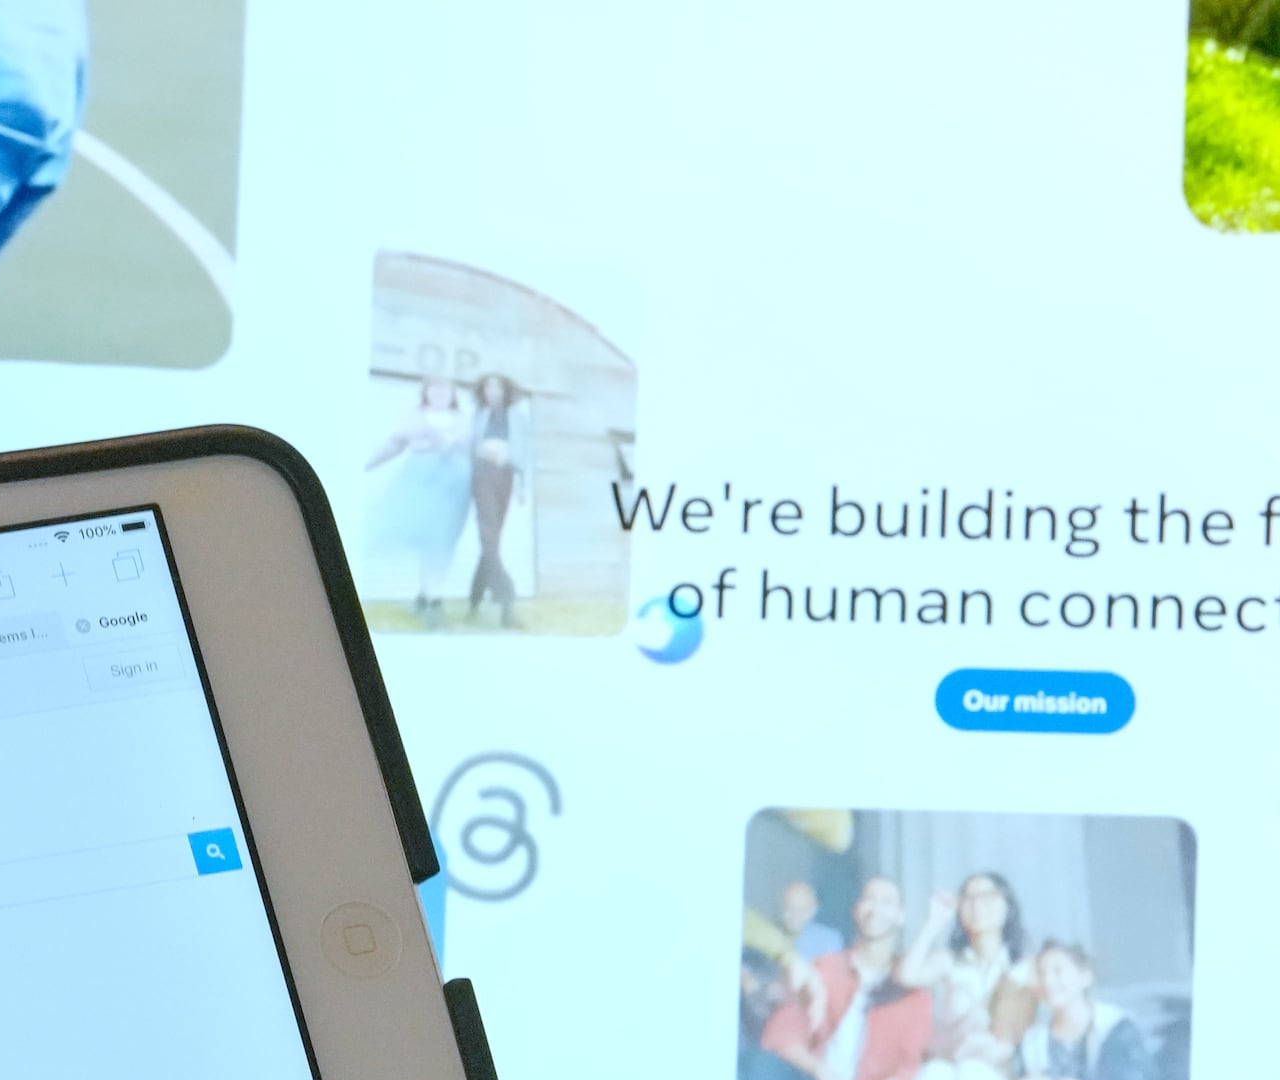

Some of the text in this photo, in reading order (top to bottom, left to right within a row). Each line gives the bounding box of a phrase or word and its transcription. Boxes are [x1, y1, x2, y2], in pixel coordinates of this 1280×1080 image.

[611, 482, 804, 537] We're
[830, 486, 1103, 558] building
[1123, 493, 1235, 545] the
[79, 524, 117, 540] 100%
[668, 568, 736, 620] of
[760, 570, 994, 626] human
[99, 611, 148, 629] Google
[110, 660, 158, 679] Sign in
[963, 689, 1107, 715] Our mission
